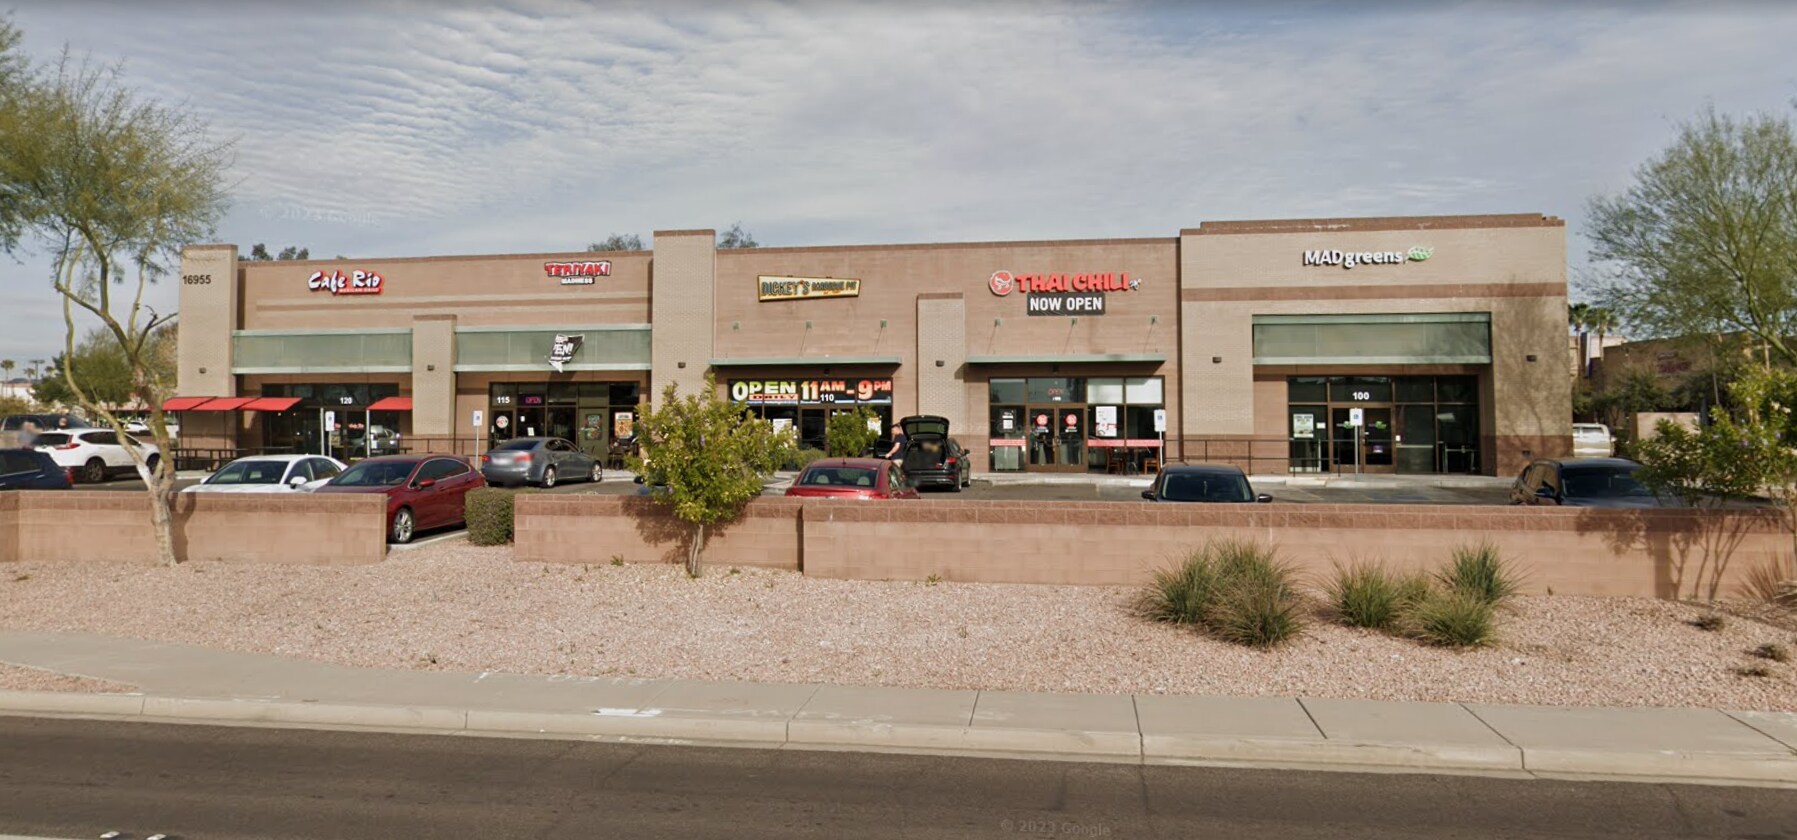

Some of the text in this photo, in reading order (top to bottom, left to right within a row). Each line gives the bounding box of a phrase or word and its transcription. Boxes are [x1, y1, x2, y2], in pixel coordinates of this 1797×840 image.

[545, 262, 611, 276] TERIYAKI
[182, 275, 211, 285] 16955
[308, 271, 346, 293] Cafe
[1015, 272, 1130, 292] THAI CHILI
[762, 280, 810, 296] DICKEY'S
[1030, 297, 1102, 311] NOW OPEN
[732, 381, 797, 401] OPEN
[820, 394, 835, 402] 110
[1352, 391, 1370, 400] 100
[340, 396, 352, 405] 120
[496, 396, 510, 404] 115
